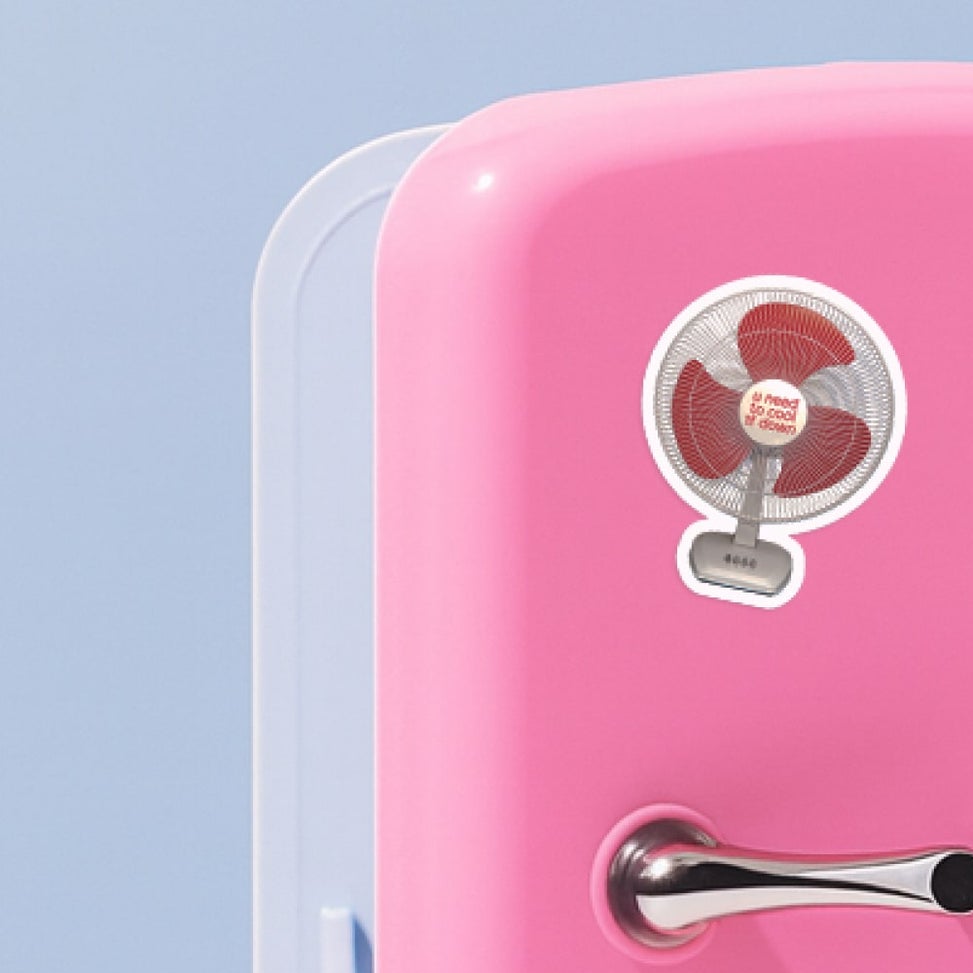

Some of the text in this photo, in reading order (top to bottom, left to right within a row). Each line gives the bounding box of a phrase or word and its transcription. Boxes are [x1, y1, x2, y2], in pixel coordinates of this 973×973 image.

[764, 393, 799, 410] need
[767, 408, 797, 421] cool
[759, 418, 797, 435] down
